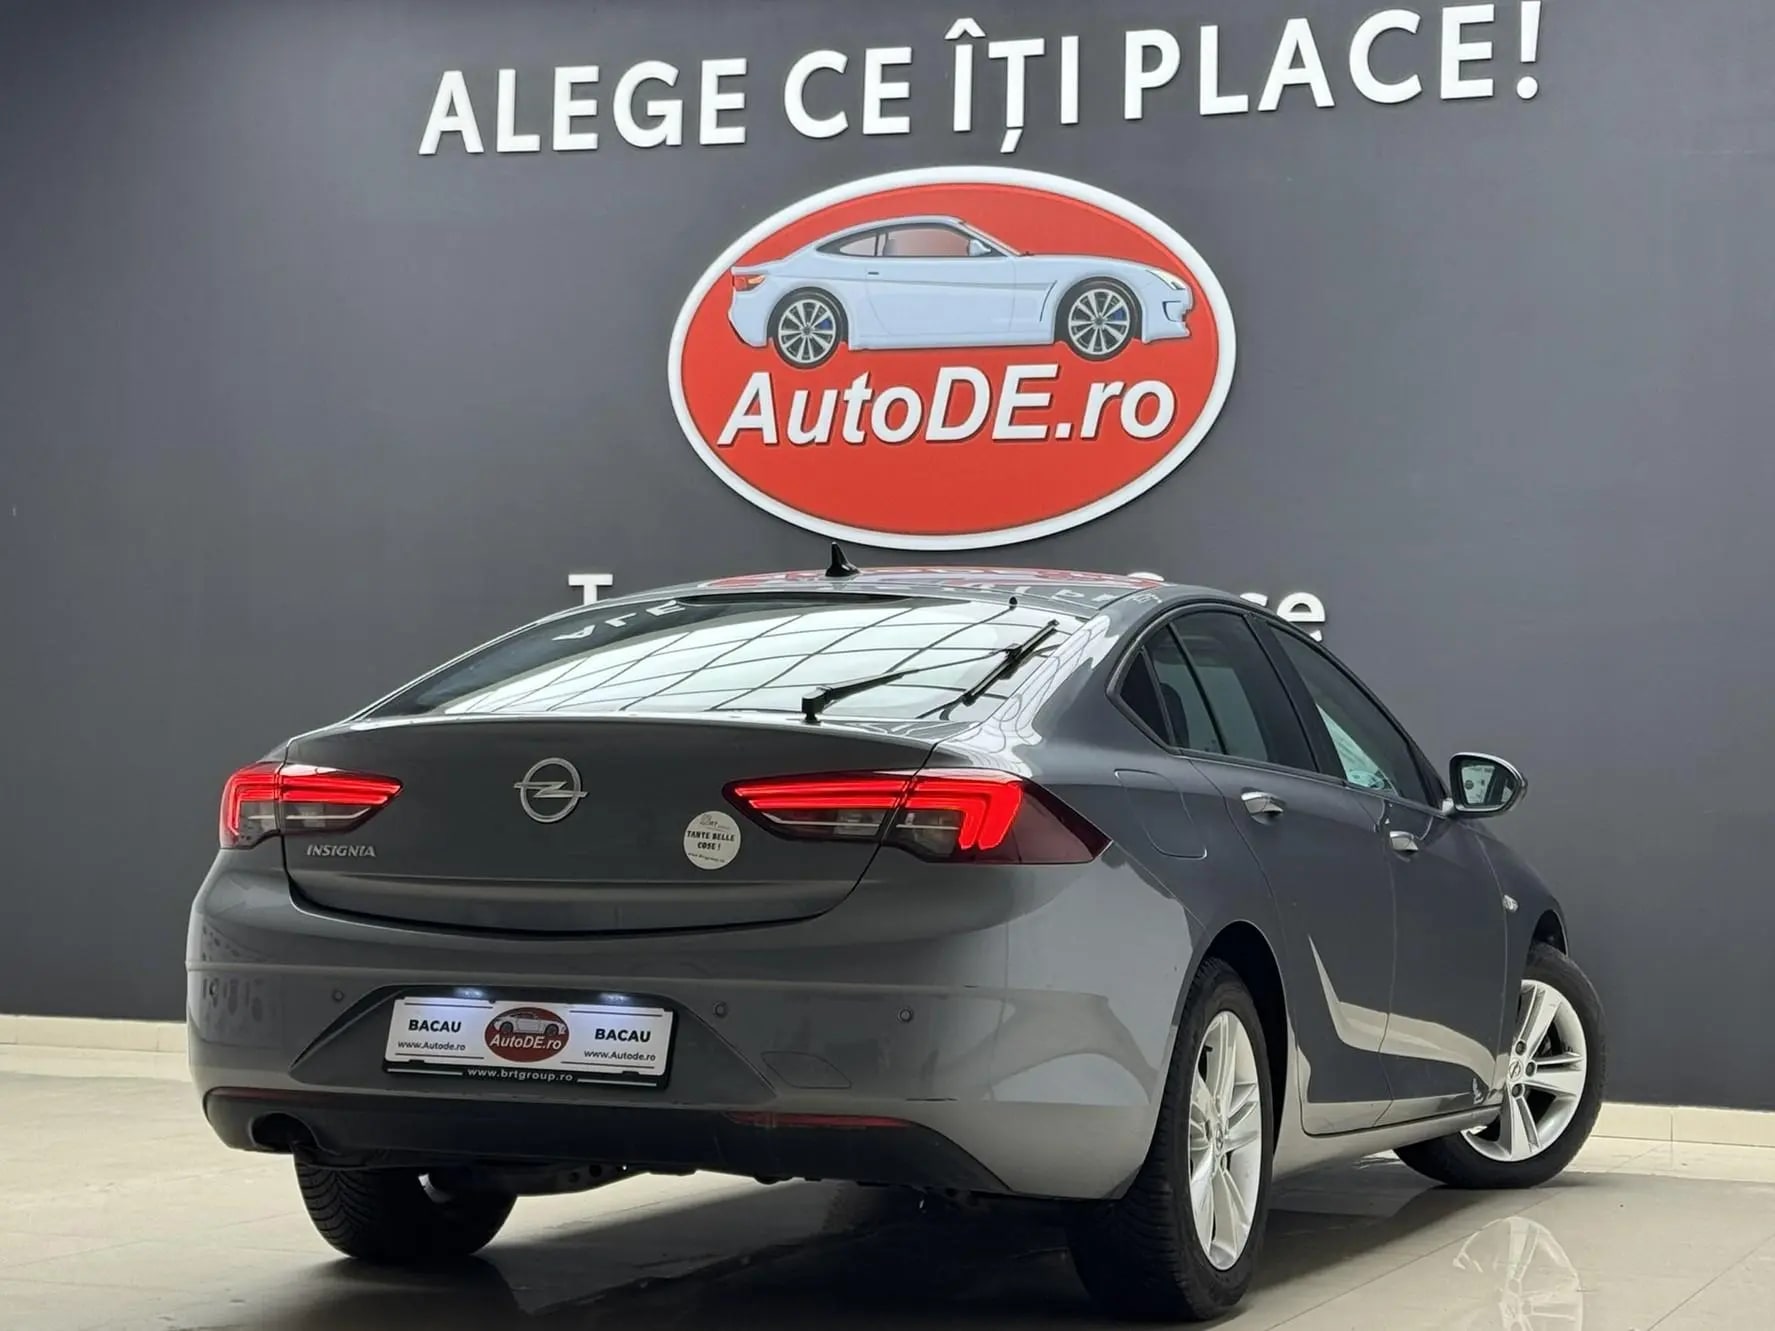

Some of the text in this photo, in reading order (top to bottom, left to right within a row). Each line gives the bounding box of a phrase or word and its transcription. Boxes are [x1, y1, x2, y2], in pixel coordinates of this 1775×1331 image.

[418, 58, 748, 155] ALEGE
[784, 46, 914, 138] CE
[1124, 0, 1542, 121] PLACE!
[717, 363, 1177, 446] AutoDE.ro
[687, 830, 735, 842] TANTE BELLE
[306, 845, 376, 857] INSIGNIA
[697, 841, 716, 850] COSE
[408, 1019, 462, 1033] BACAU
[489, 1033, 563, 1051] AutoDE.ro
[594, 1028, 652, 1043] BACAU
[397, 1041, 467, 1051] www.Autode.ro
[583, 1050, 657, 1062] www.Autode.ro
[467, 1067, 573, 1082] www.brtgroup.ro
